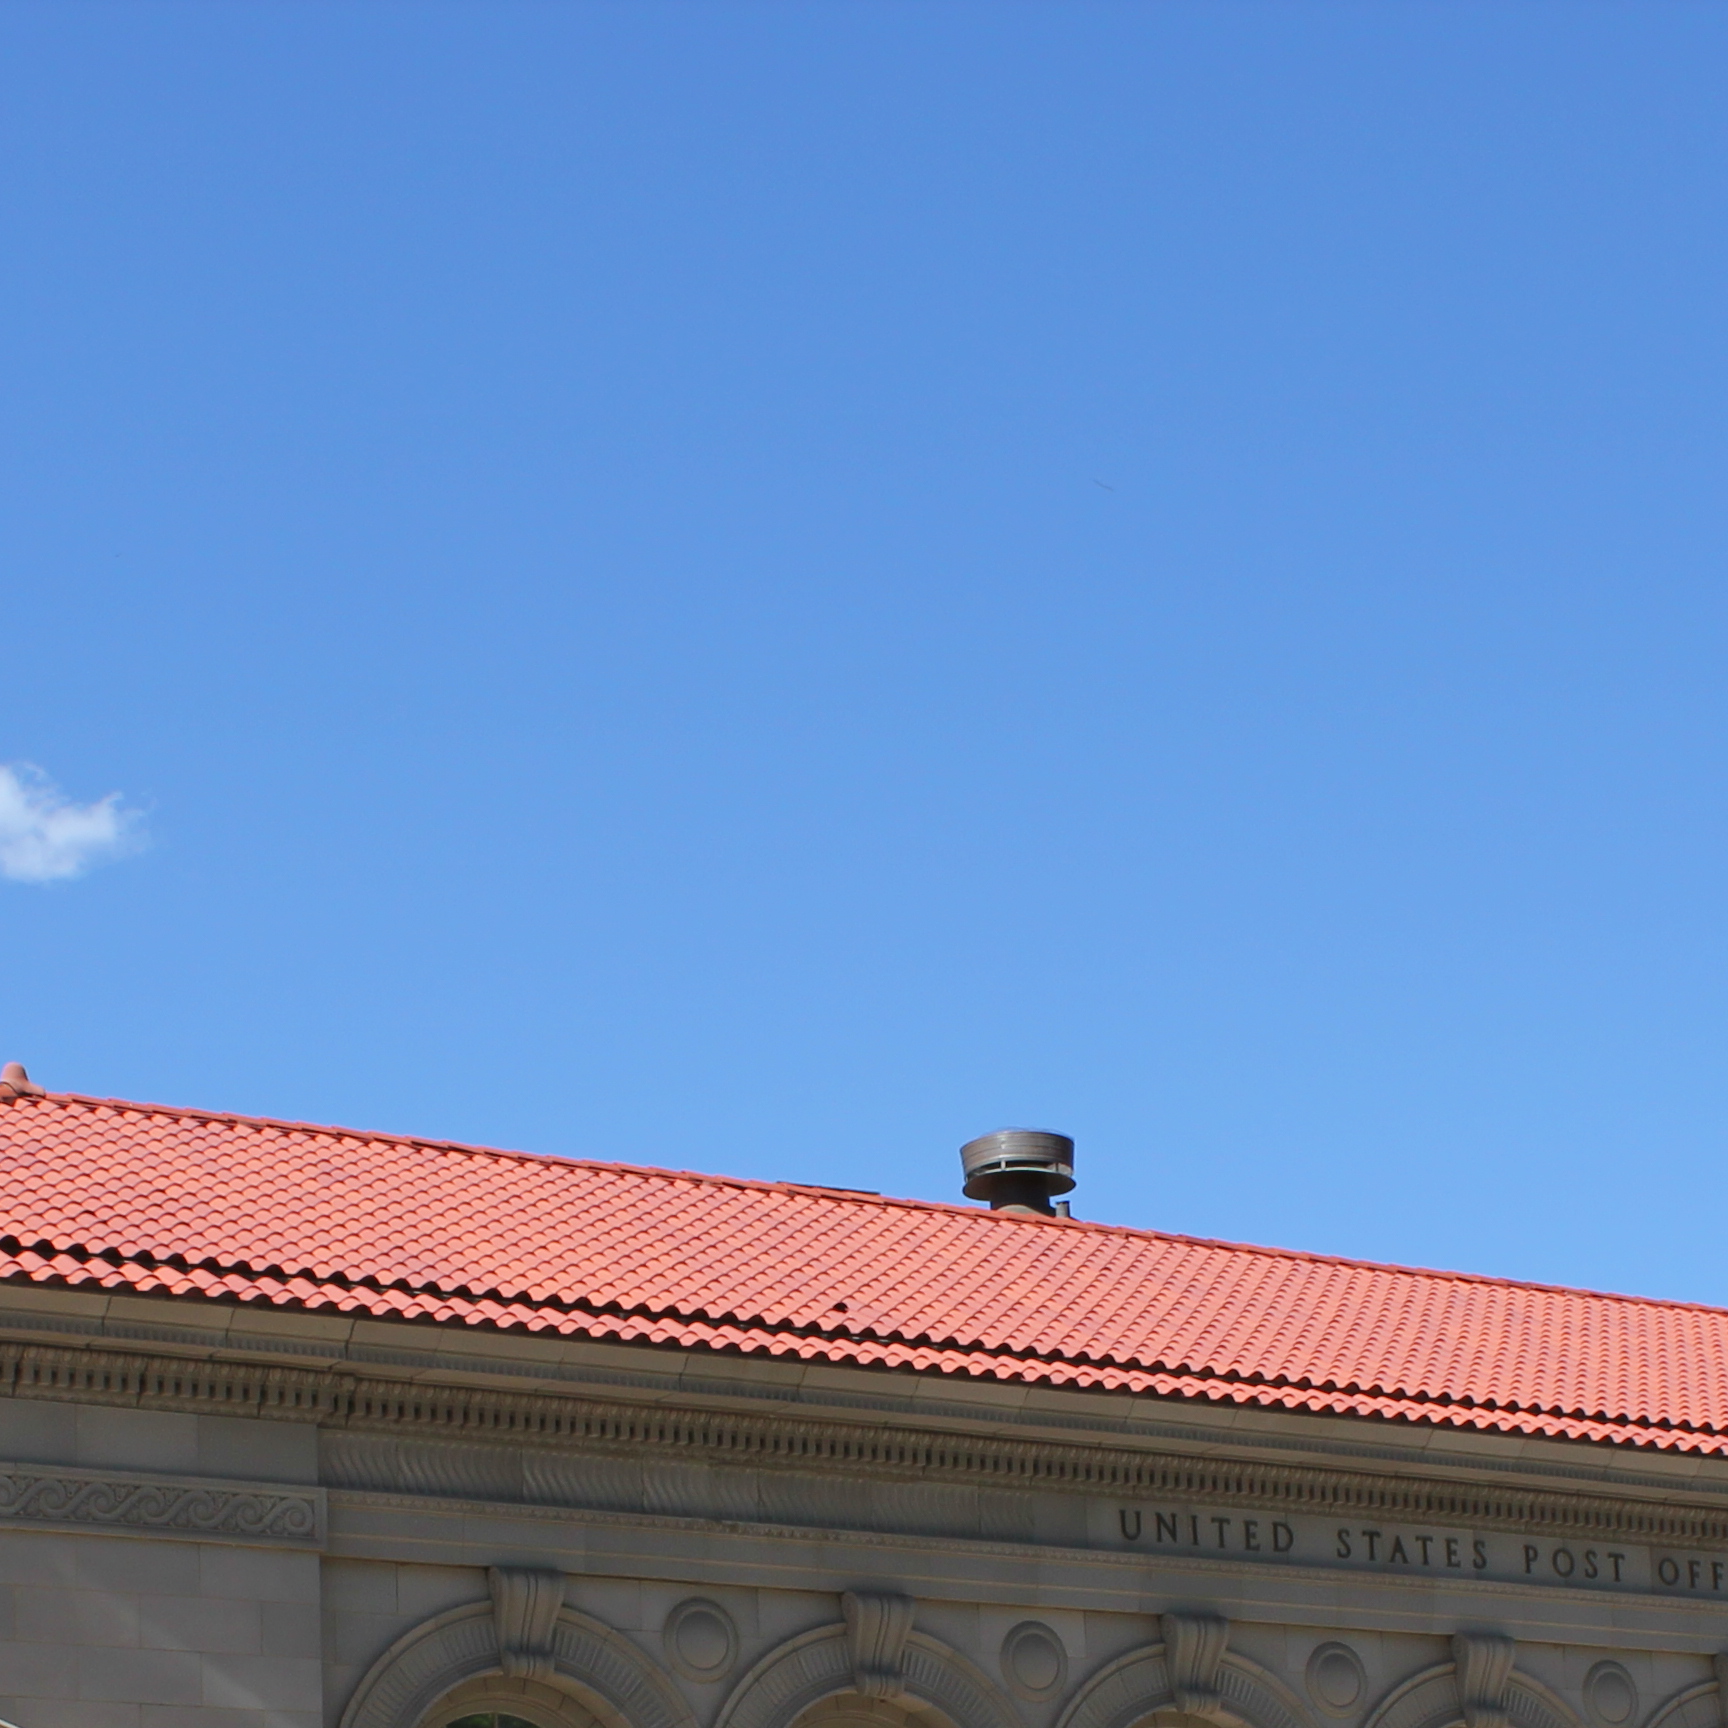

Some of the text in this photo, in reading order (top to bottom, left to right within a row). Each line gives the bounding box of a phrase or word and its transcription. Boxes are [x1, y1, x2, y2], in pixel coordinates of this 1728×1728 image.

[1118, 1508, 1295, 1553] UNITED
[1335, 1527, 1488, 1571] STATES
[1522, 1544, 1626, 1583] POST
